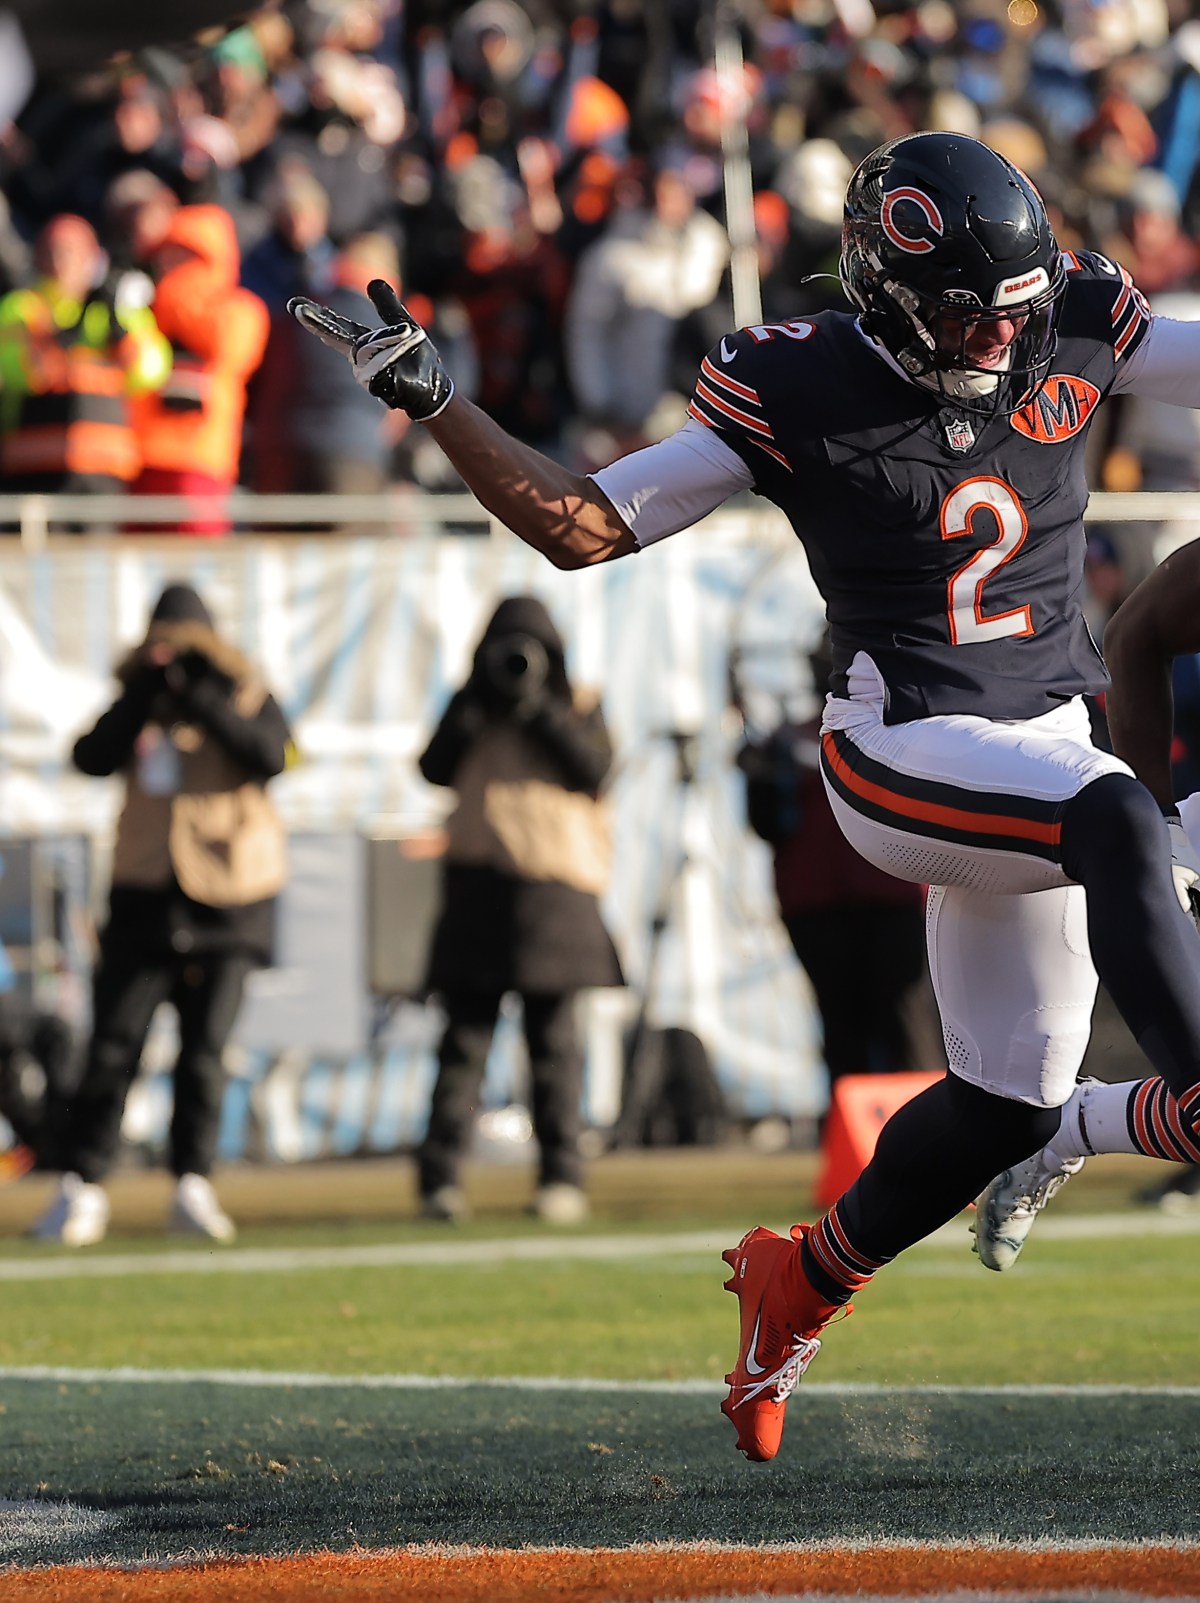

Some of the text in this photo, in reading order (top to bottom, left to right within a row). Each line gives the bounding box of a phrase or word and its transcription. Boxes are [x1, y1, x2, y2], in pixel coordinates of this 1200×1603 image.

[881, 186, 944, 254] C
[1004, 273, 1042, 293] BEARS
[942, 297, 977, 305] OAKLEY
[743, 319, 817, 345] 2
[939, 475, 1036, 646] 2
